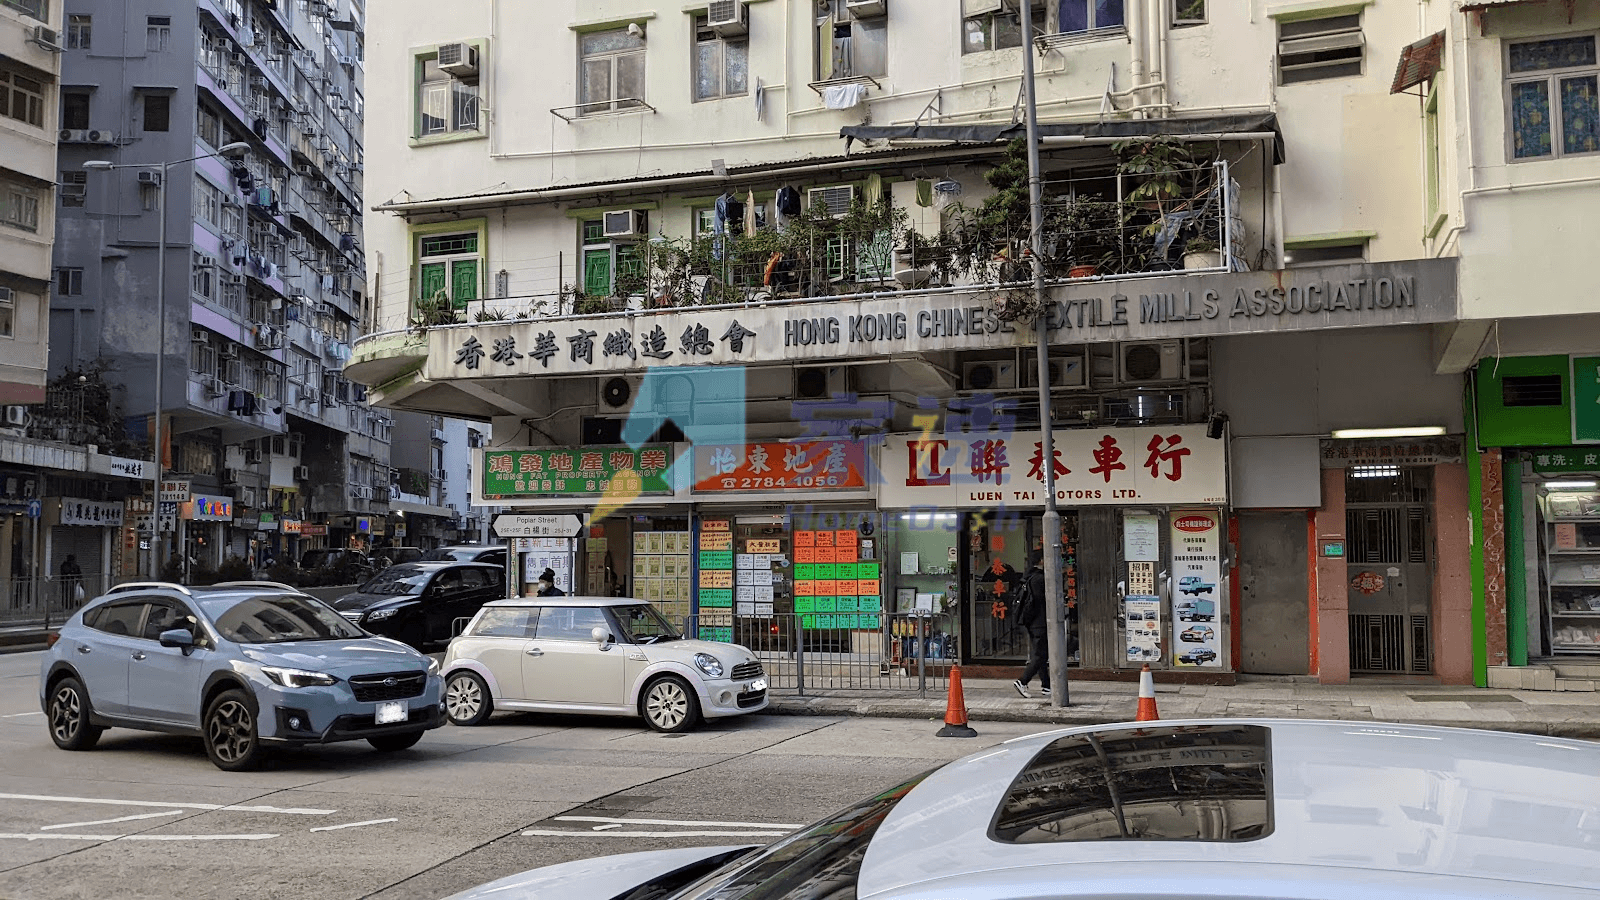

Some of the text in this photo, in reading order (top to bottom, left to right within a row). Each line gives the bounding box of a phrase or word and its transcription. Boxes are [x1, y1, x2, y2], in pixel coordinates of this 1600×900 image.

[784, 316, 839, 347] HONG
[848, 311, 908, 343] KONG
[1031, 294, 1128, 330] EXTILE
[1139, 288, 1220, 323] MILLS
[1228, 276, 1416, 318] ASSOCIATION
[454, 319, 756, 369] 香港華商織造總會
[489, 450, 666, 473] 鴻發地產物業
[710, 443, 850, 475] 怡東地產
[970, 434, 1191, 486] 聯泰車行
[555, 471, 608, 479] PROPERTY
[615, 469, 658, 478] AGENCY
[741, 475, 838, 488] 2784 1056
[970, 489, 1141, 501] LUEN TAI OTORS LTD.
[537, 516, 557, 524] Street
[523, 526, 550, 535] 白楊街
